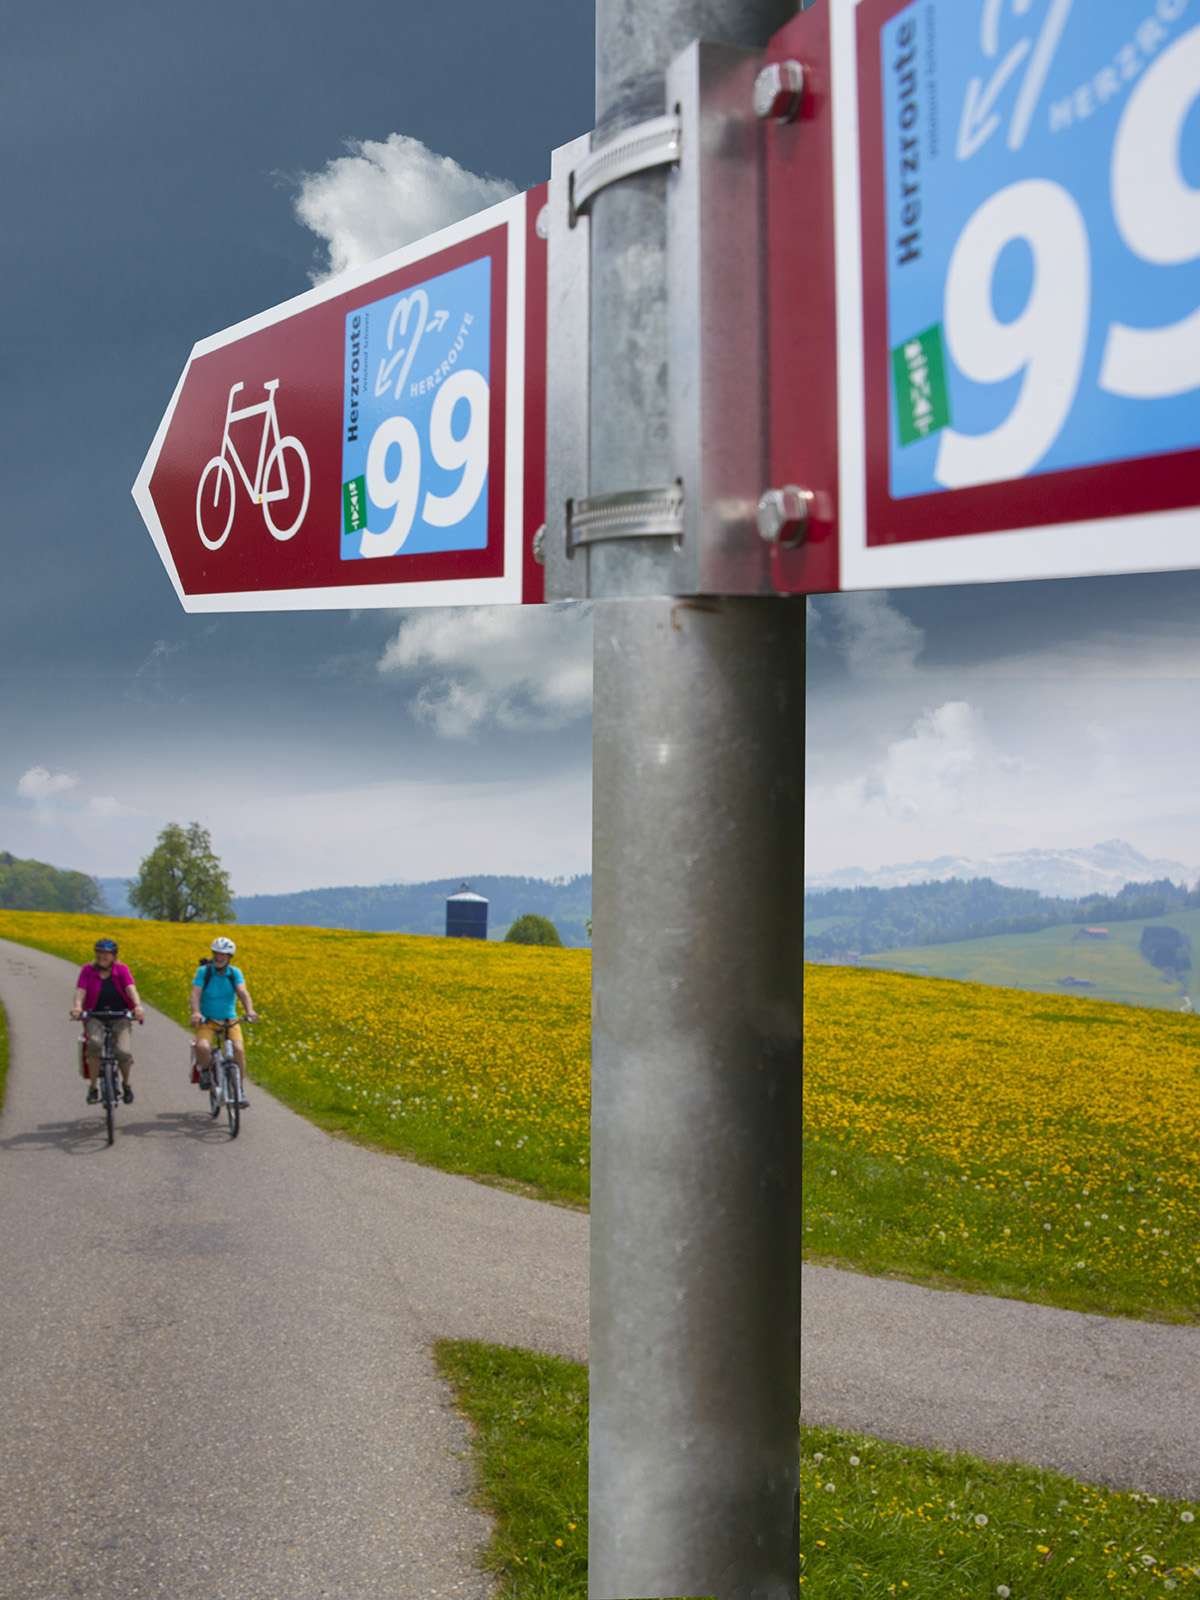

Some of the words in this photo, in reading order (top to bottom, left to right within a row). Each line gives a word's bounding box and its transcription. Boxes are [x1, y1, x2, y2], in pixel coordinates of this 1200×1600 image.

[896, 17, 922, 267] Herzroute
[347, 313, 361, 443] Herzroute
[410, 312, 475, 397] HERZROUTE
[359, 369, 489, 560] 99
